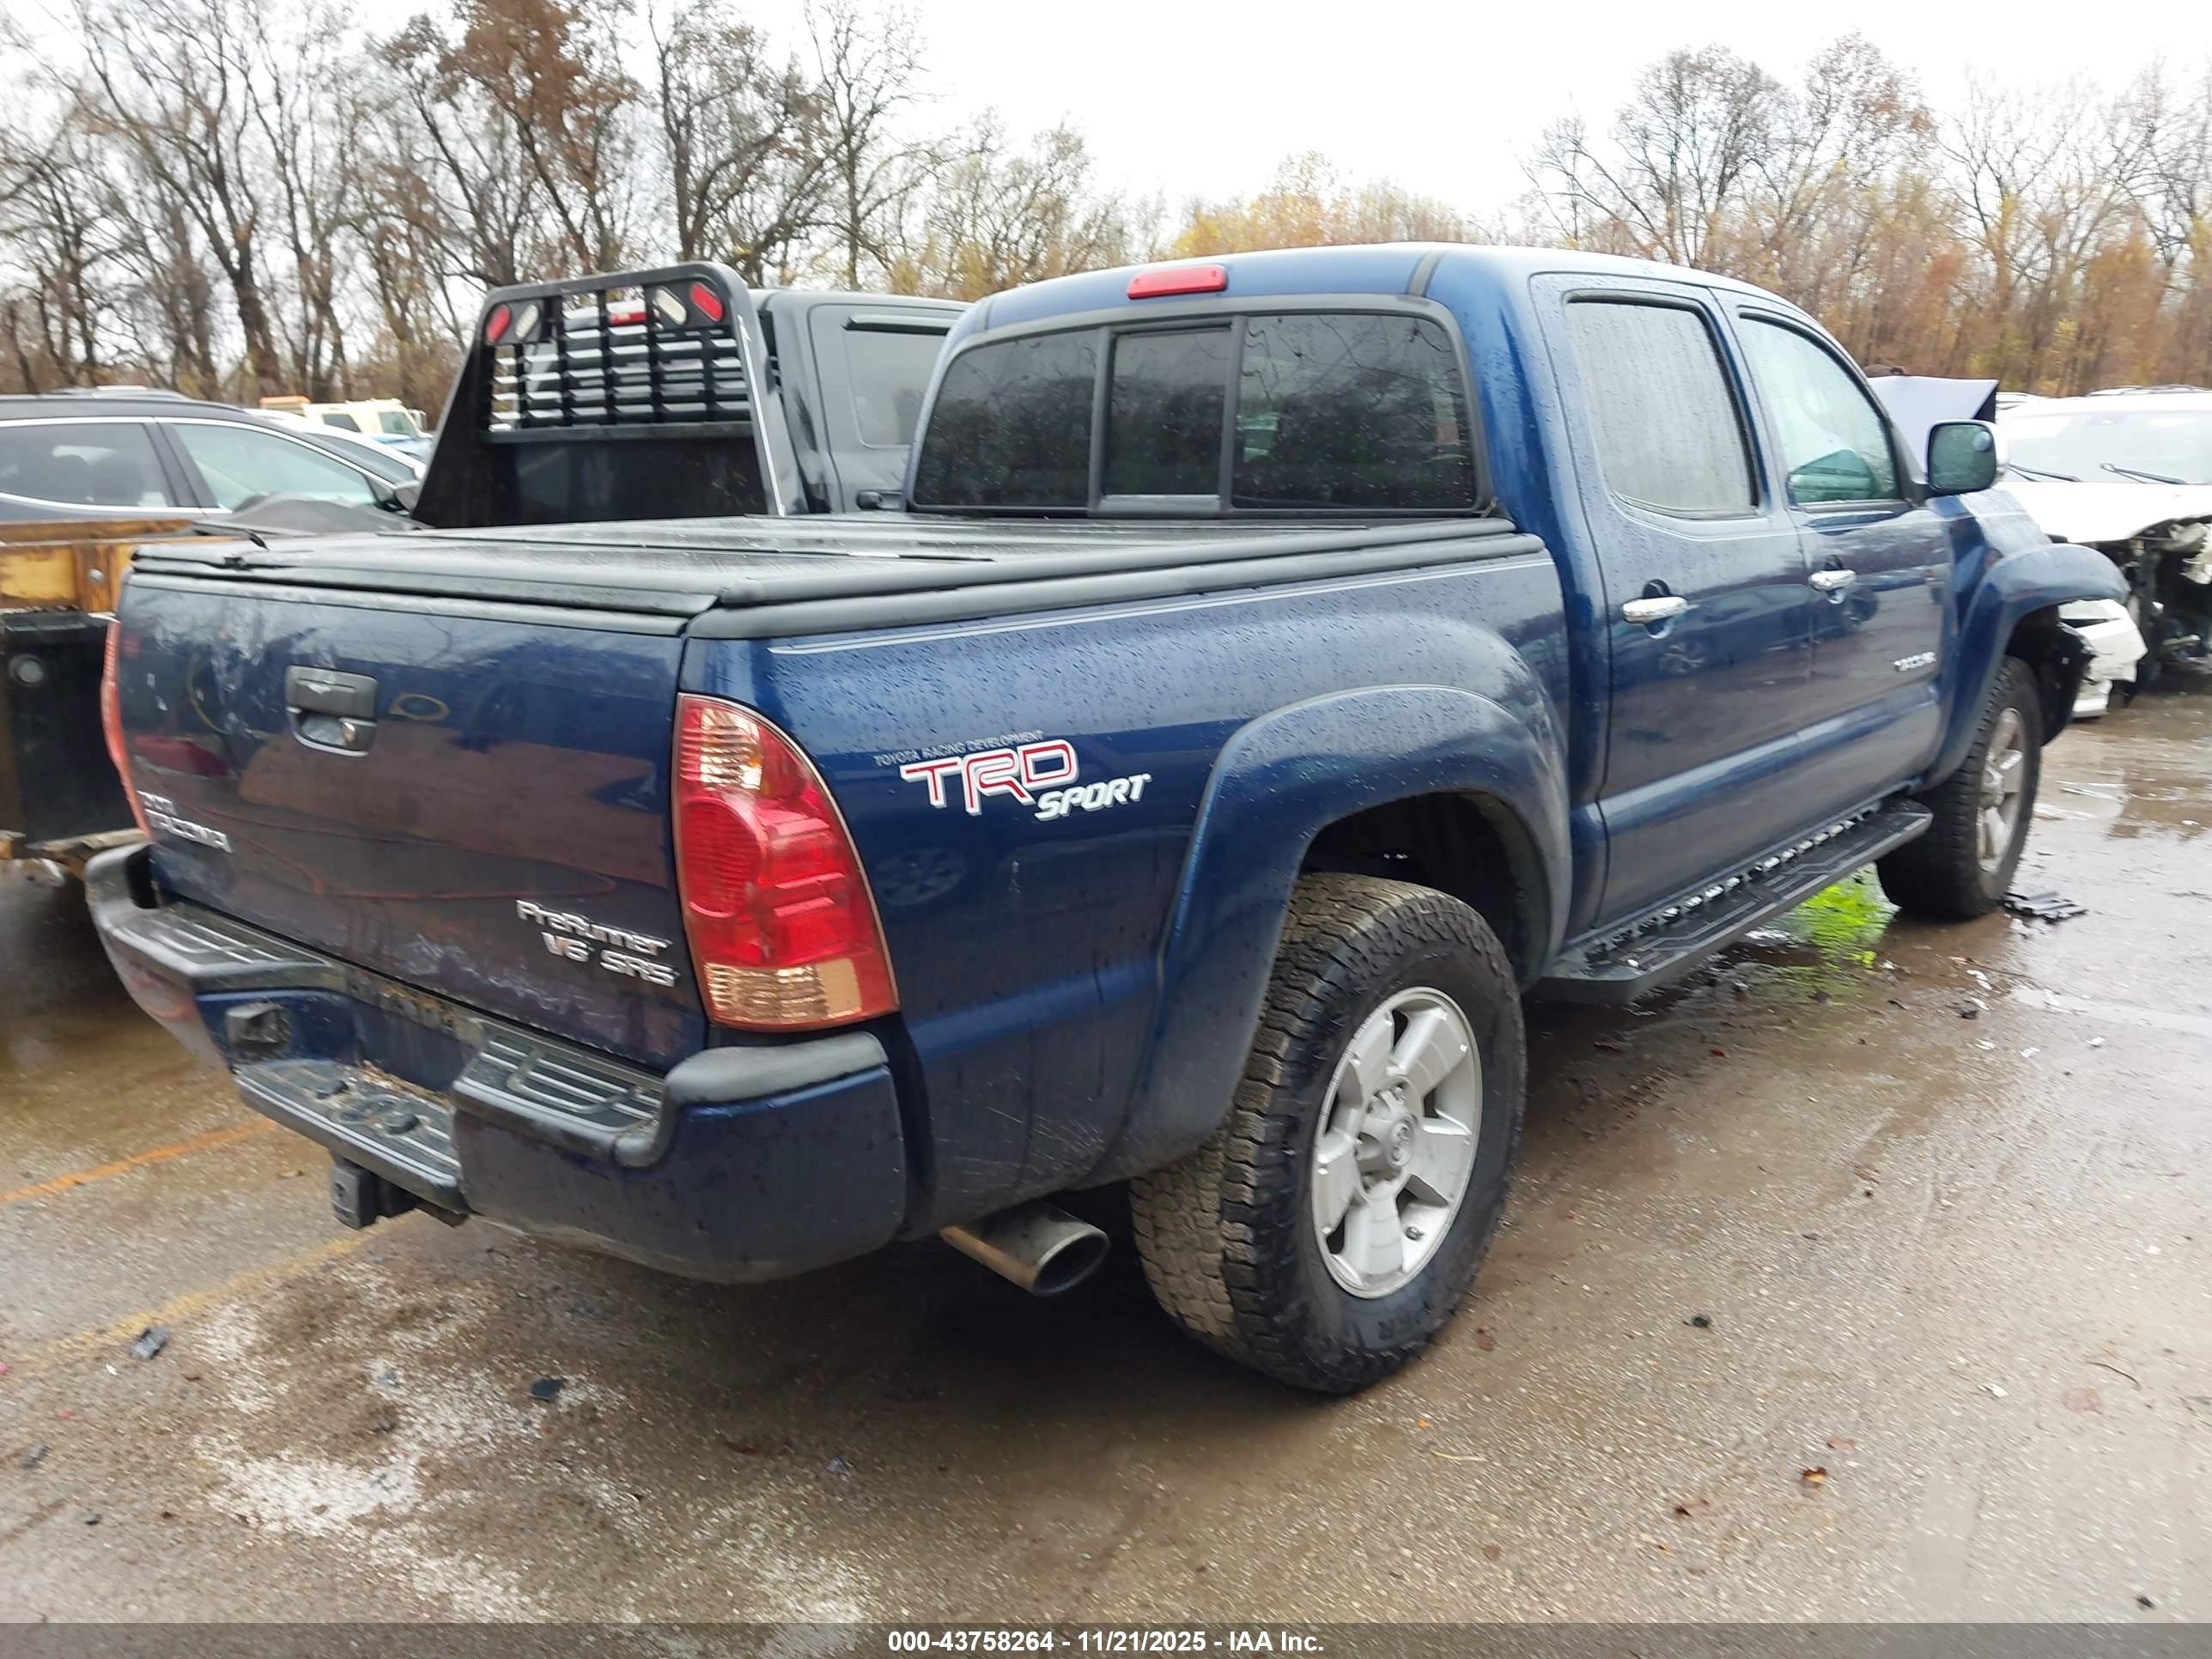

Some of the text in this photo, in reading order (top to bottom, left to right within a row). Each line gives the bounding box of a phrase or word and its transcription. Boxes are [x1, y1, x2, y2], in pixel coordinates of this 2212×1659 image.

[872, 730, 1044, 767] TOYOTA RACING DEVELOPMENT
[899, 738, 1080, 817] TRD
[1034, 773, 1152, 822] SPORT
[542, 933, 678, 988] V6 SR5
